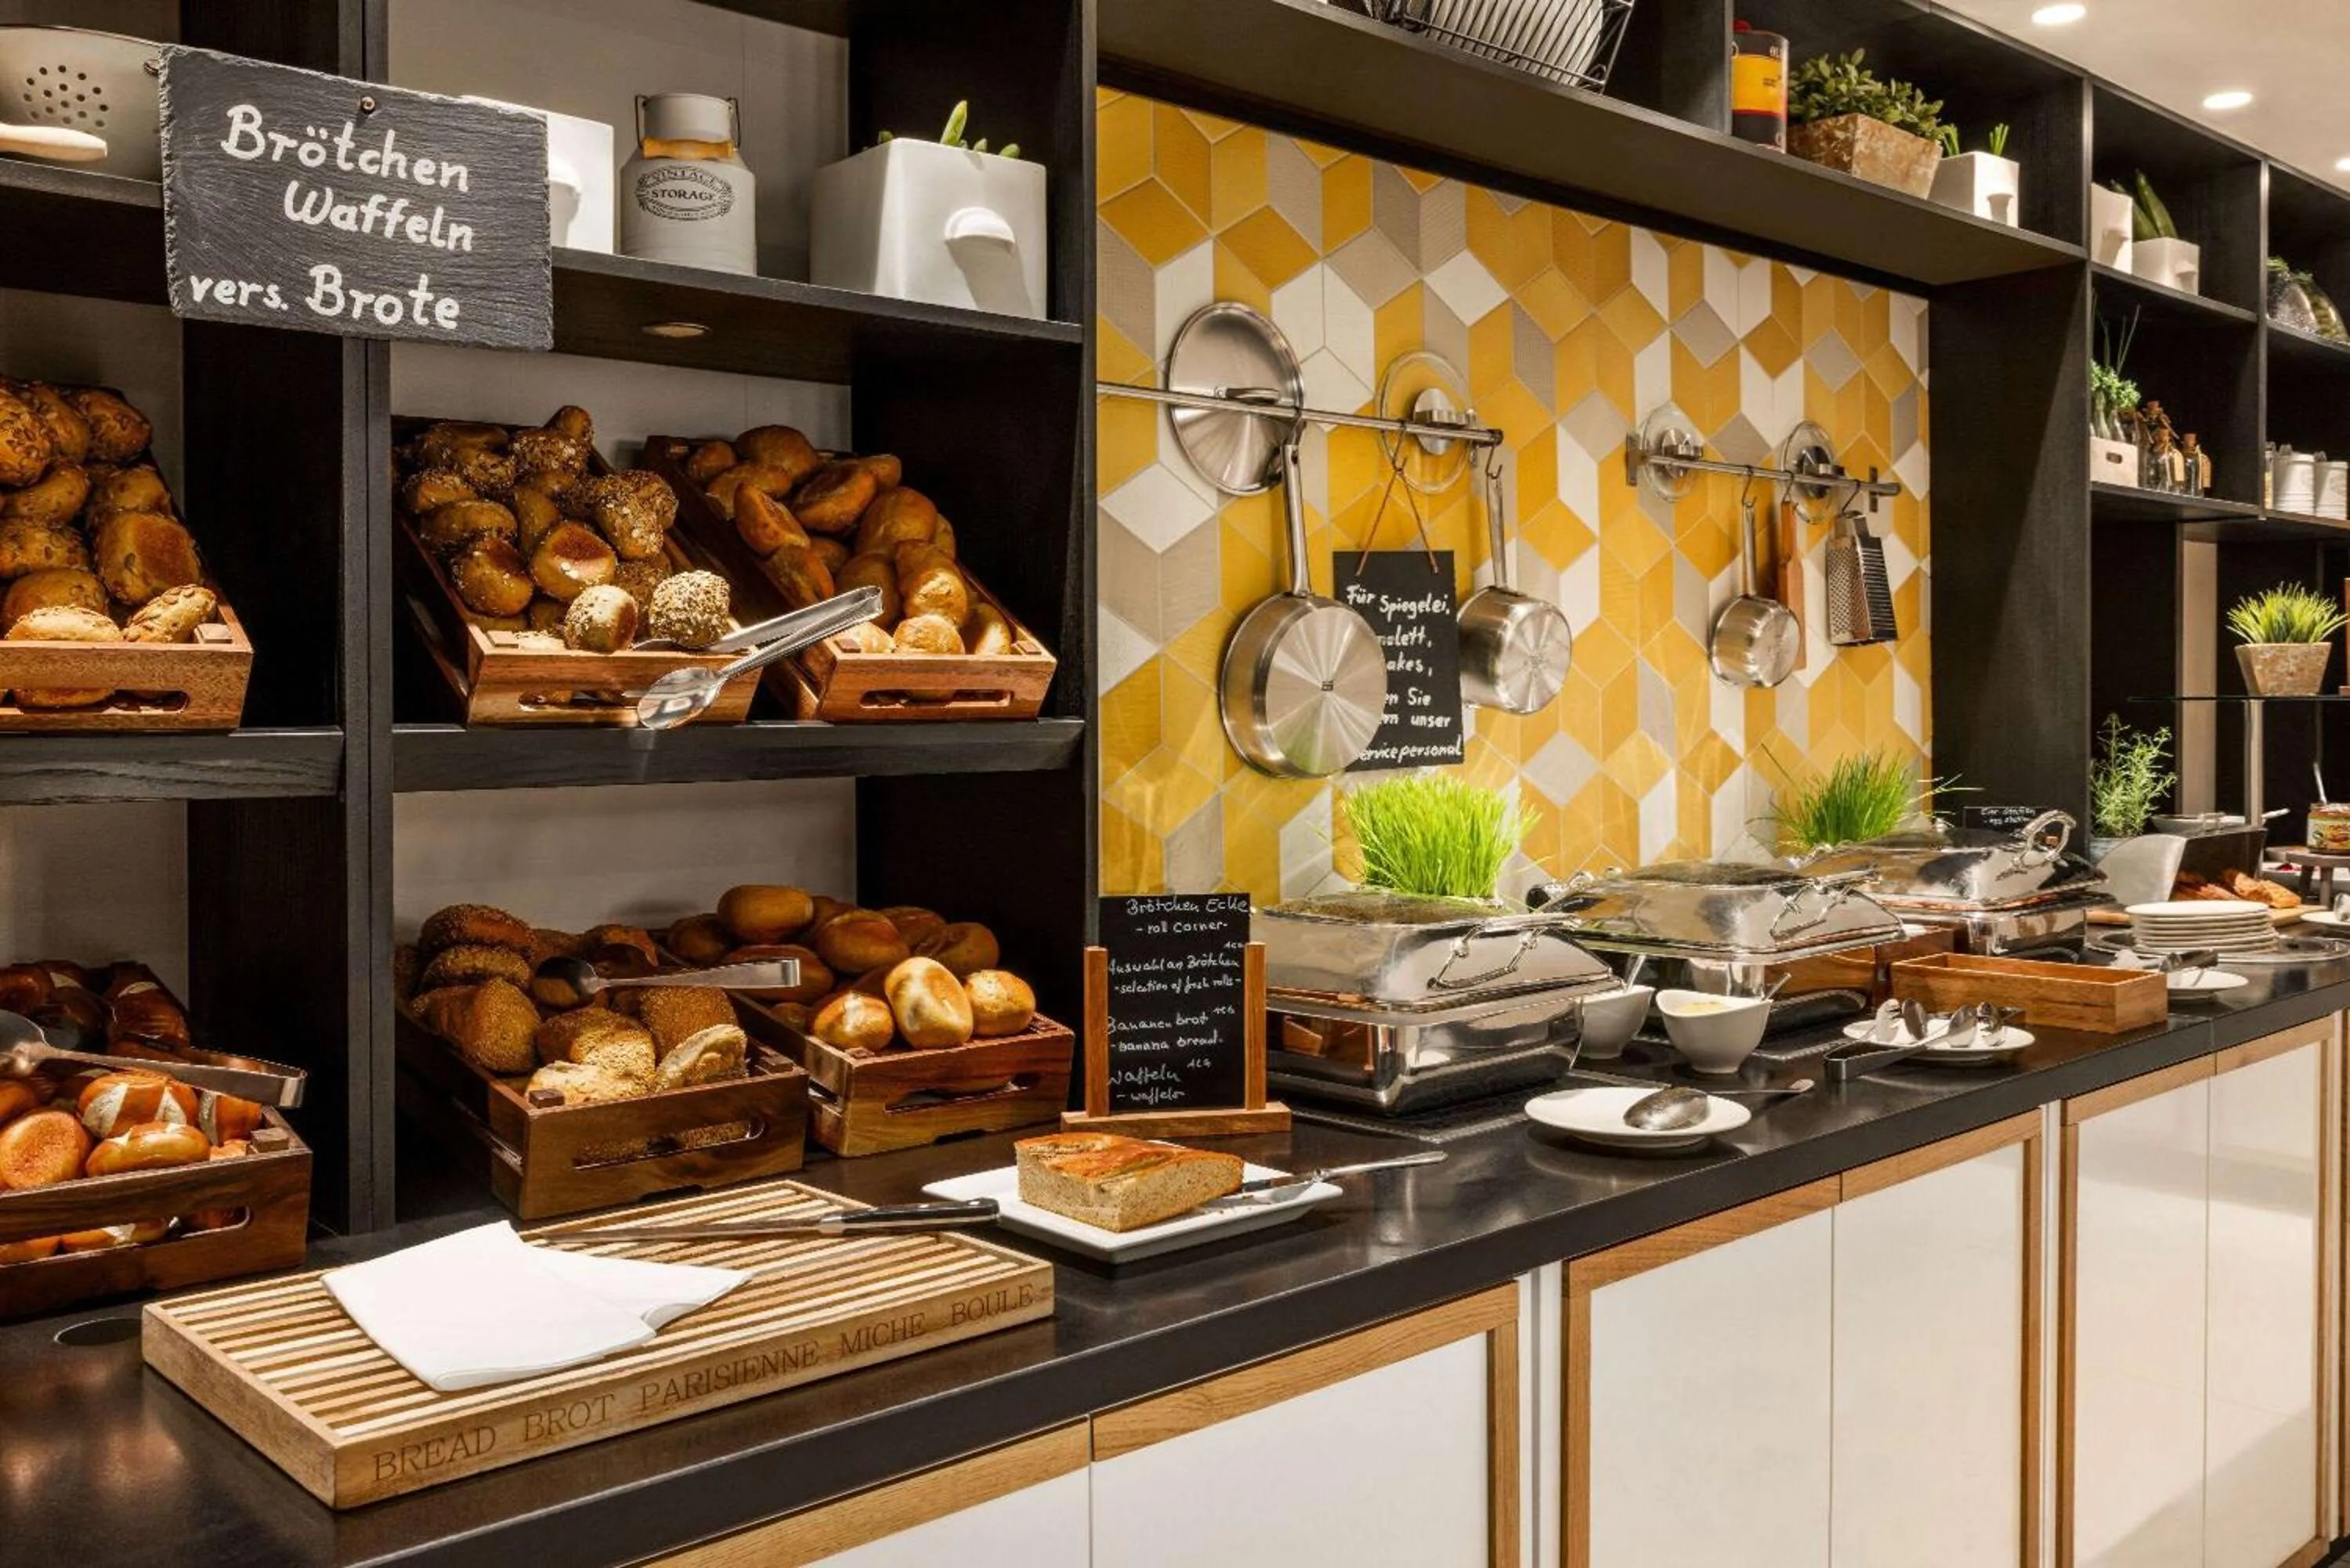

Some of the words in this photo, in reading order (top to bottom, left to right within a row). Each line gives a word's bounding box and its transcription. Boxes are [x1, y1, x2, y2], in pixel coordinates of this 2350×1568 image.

[220, 104, 469, 192] Brötchen
[284, 180, 472, 251] Waffeln
[190, 274, 288, 311] vers.
[305, 264, 460, 330] Brote
[1346, 584, 1376, 605] Für
[1408, 687, 1432, 706] Sie
[1410, 715, 1452, 728] unser
[1126, 896, 1199, 916] Brötchen
[1206, 895, 1249, 913] Ecke
[1166, 961, 1184, 970] an
[1187, 952, 1240, 969] Brötchen
[1171, 979, 1182, 994] of
[1184, 976, 1209, 994] fresh
[372, 1425, 497, 1481] BREAD
[523, 1393, 616, 1443] BROT
[639, 1339, 820, 1410] PARISIENNE
[838, 1311, 927, 1359] MICHE
[949, 1282, 1035, 1329] BOULE
